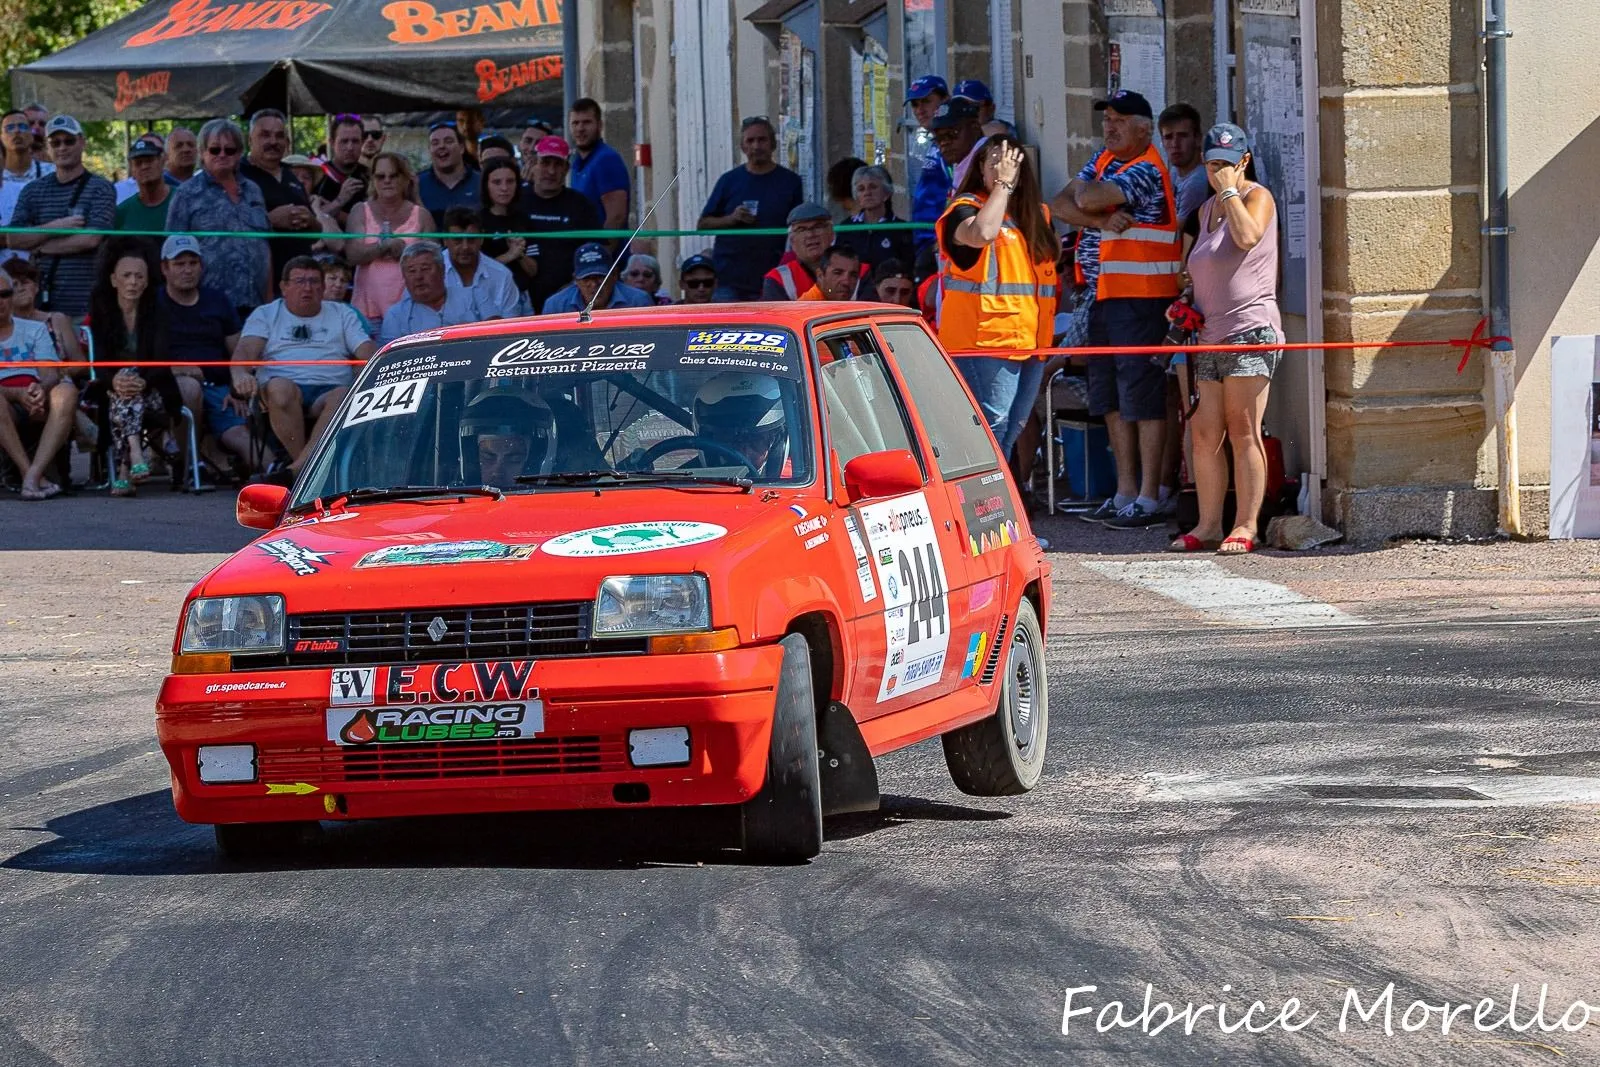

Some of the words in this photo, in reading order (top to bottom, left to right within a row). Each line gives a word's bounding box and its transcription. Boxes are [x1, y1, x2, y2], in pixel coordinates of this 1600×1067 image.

[716, 332, 785, 346] BPS
[376, 373, 386, 381] 17
[386, 370, 402, 378] rue
[403, 361, 439, 373] Anatole
[440, 359, 472, 368] France
[379, 364, 389, 373] 03
[391, 361, 401, 370] 85
[402, 359, 413, 367] 55
[425, 355, 437, 363] 05
[485, 363, 577, 378] Restaurant
[580, 359, 647, 372] Pizzeria
[679, 356, 706, 364] Chez
[707, 357, 758, 367] Christelle
[771, 362, 789, 372] Joe
[412, 369, 448, 379] Creusot
[350, 382, 418, 421] 244
[899, 542, 946, 646] 244
[295, 640, 311, 651] GT
[311, 640, 339, 651] turbo
[205, 681, 287, 694] gtr.speedcar.free.fr
[376, 706, 521, 727] RACING
